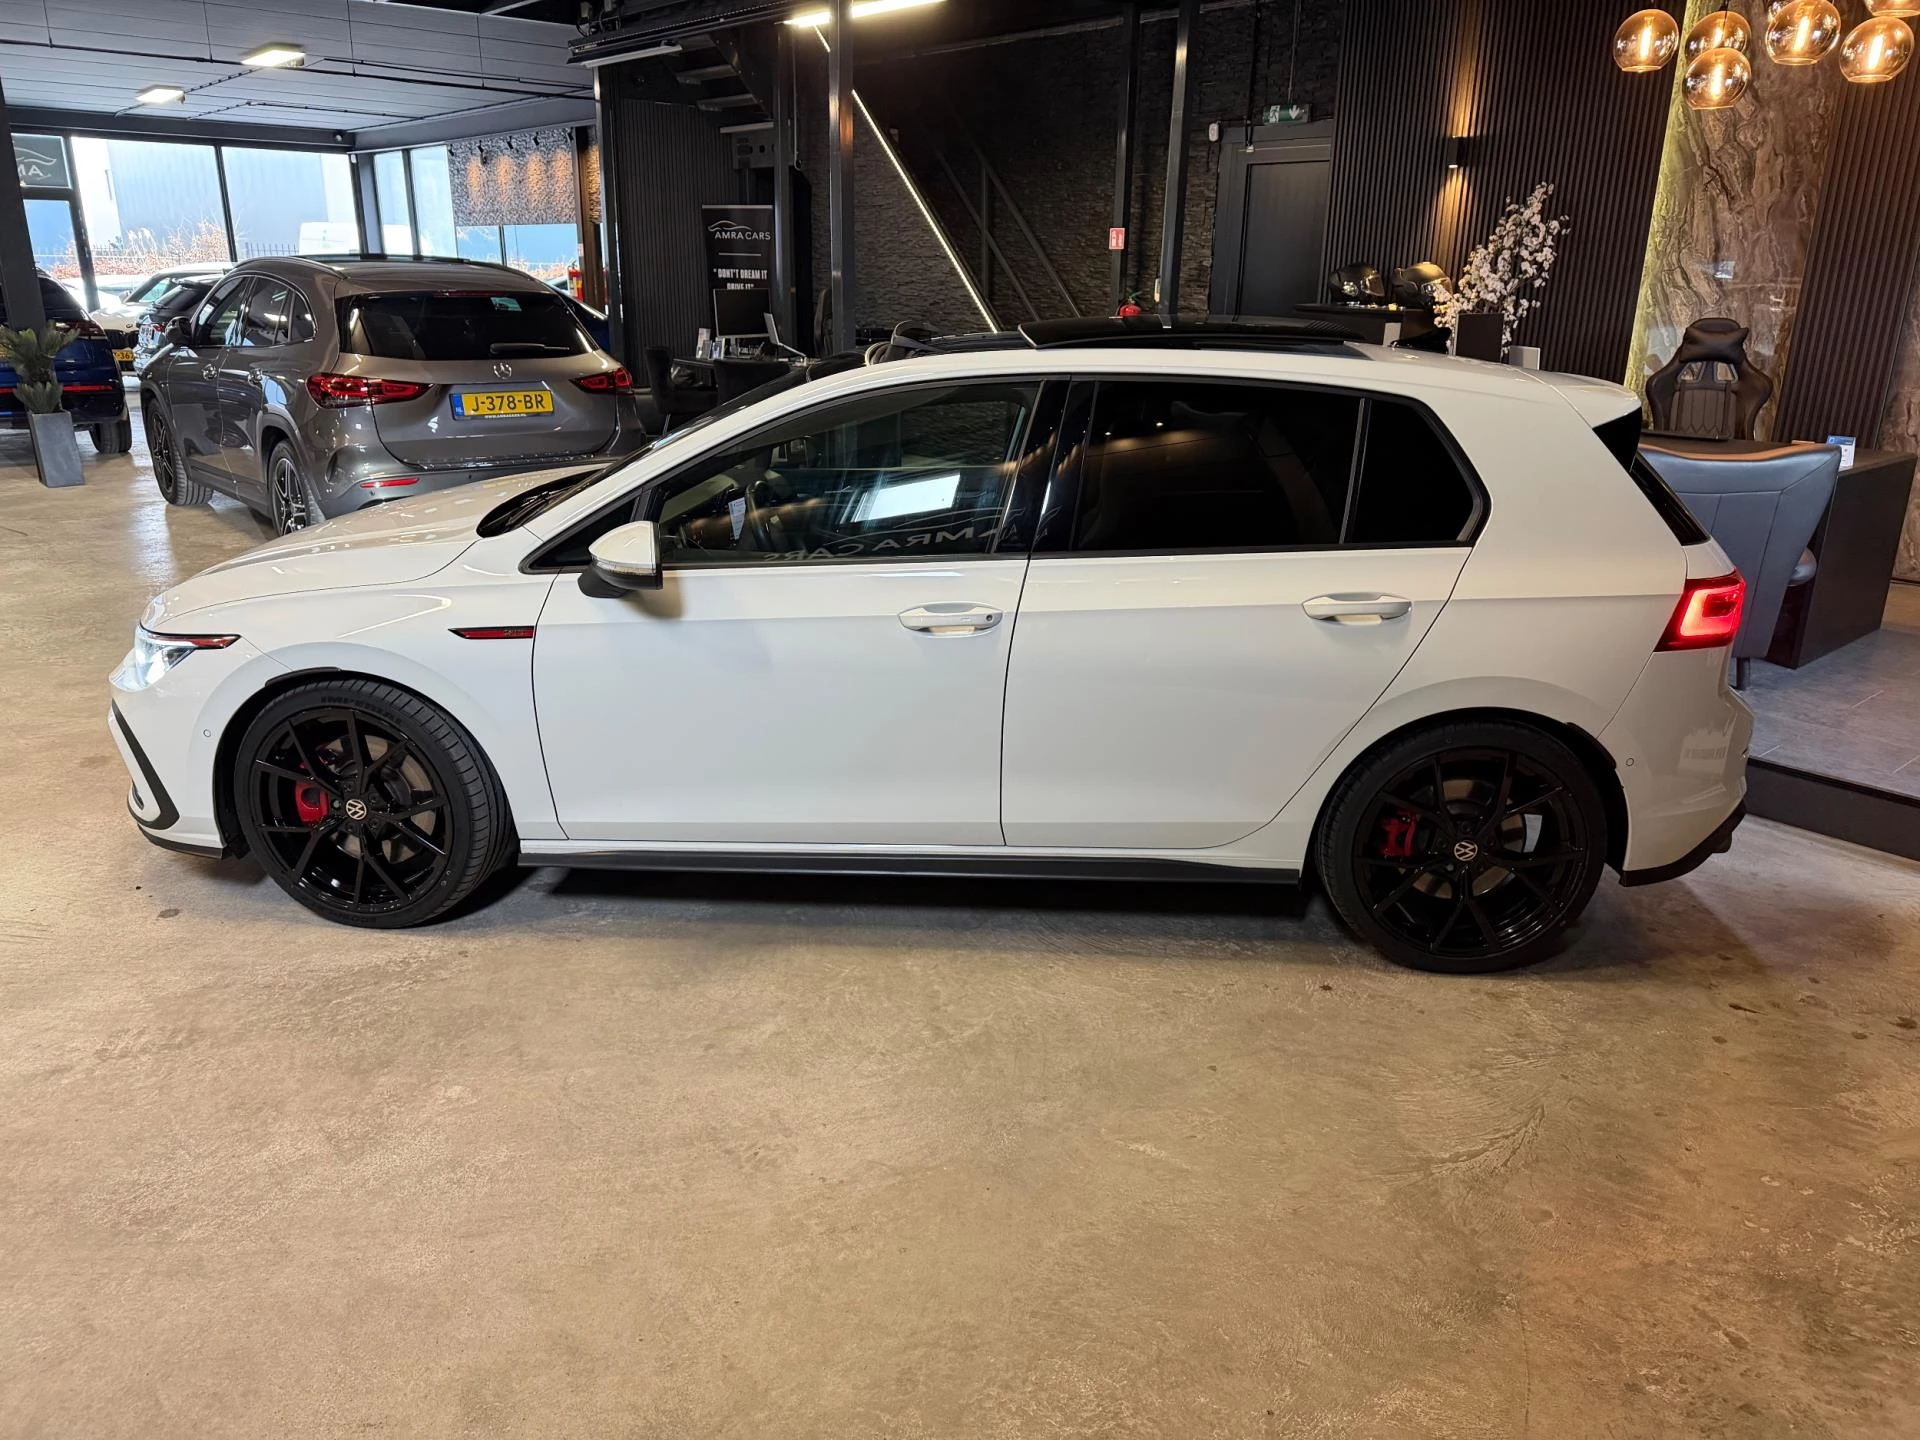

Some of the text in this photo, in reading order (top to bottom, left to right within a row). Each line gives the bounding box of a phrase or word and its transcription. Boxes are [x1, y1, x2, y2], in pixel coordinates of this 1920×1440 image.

[714, 231, 771, 240] AMRA CARS
[740, 269, 761, 280] DREAM
[761, 270, 768, 280] IT
[471, 394, 546, 412] J-378-BR
